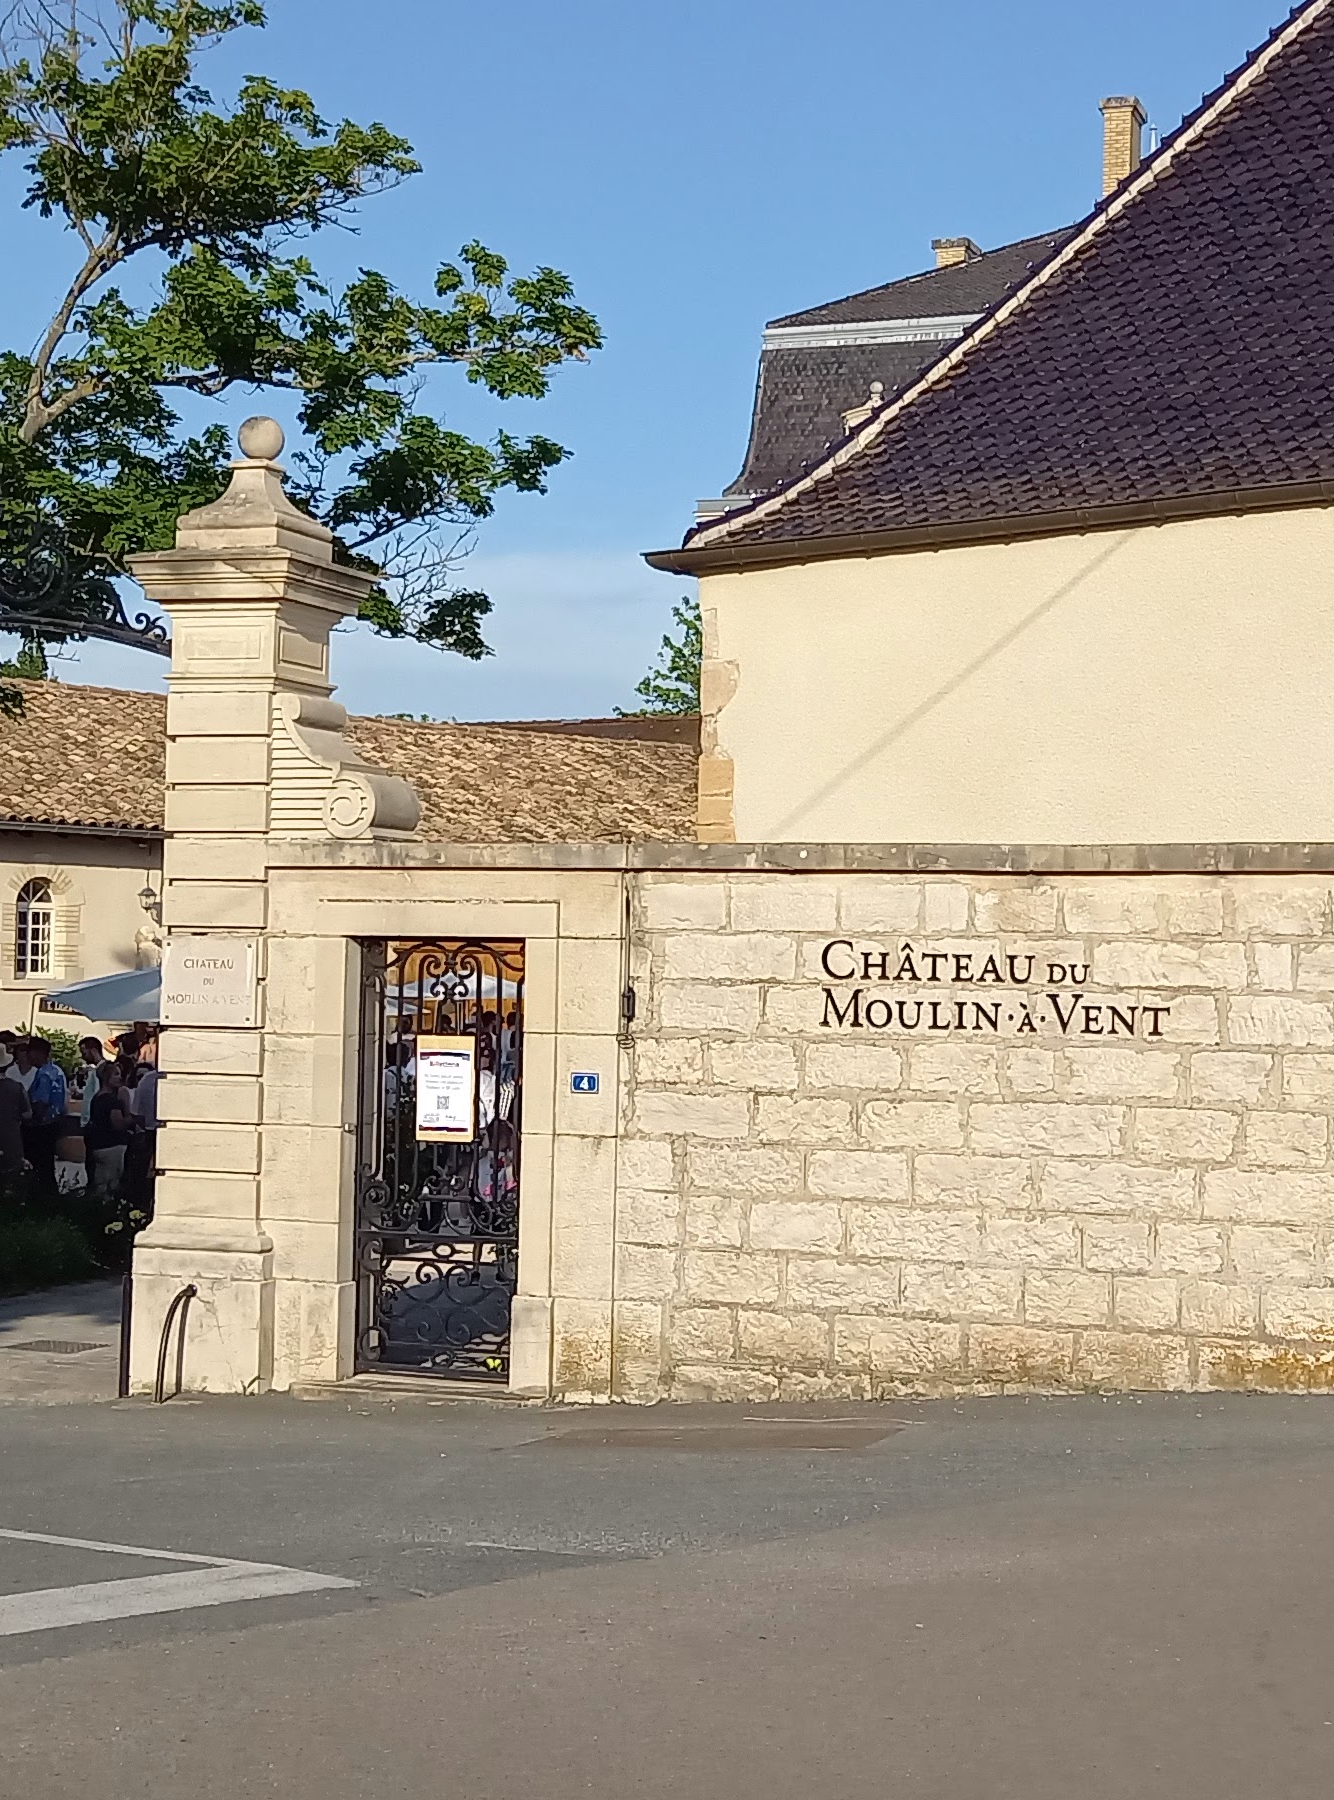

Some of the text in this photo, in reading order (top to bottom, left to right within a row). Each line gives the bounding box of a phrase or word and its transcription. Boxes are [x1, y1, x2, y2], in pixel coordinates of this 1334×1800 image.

[820, 939, 1091, 985] CHÂTEAU DU
[202, 977, 215, 986] DU
[167, 993, 209, 1004] MOULIN
[579, 1076, 589, 1090] 4
